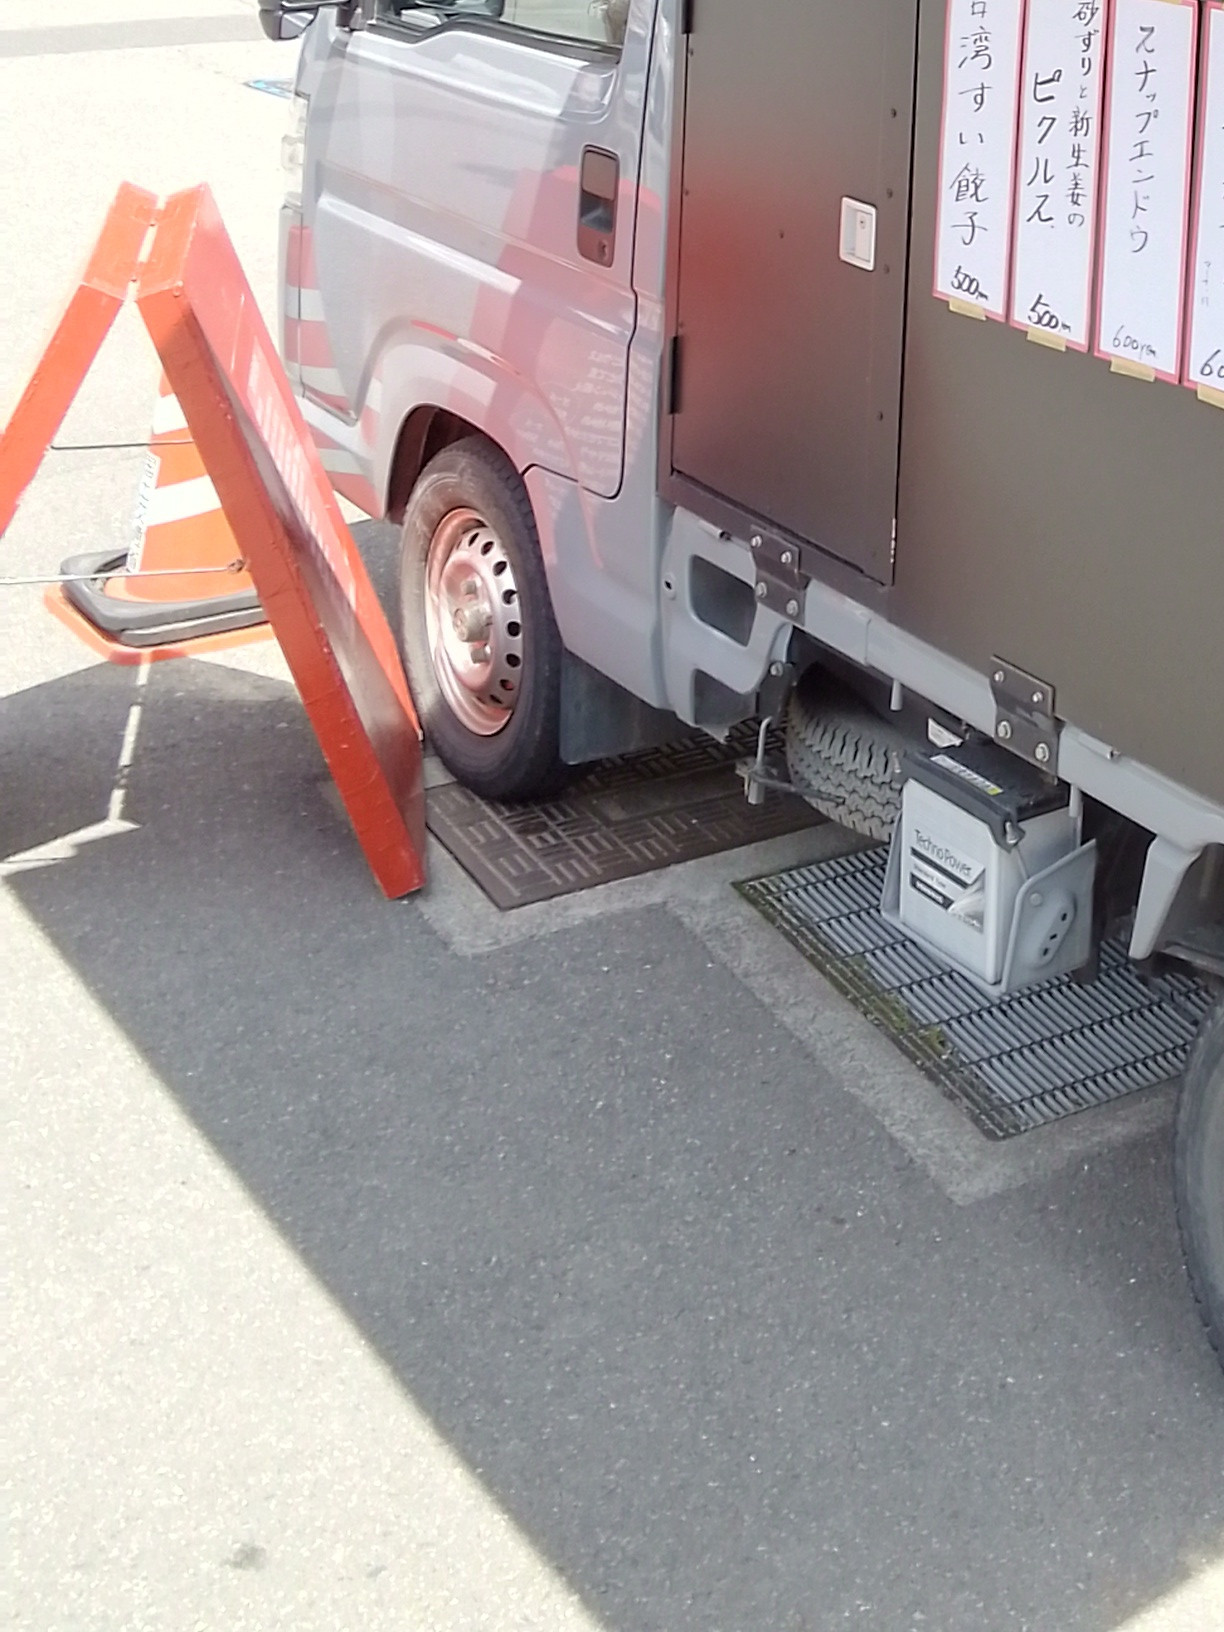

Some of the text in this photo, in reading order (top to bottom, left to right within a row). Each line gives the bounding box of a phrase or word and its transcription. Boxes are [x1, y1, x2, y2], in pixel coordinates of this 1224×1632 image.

[1026, 70, 1063, 225] ピクルス
[1128, 25, 1159, 254] スナップエンドウ
